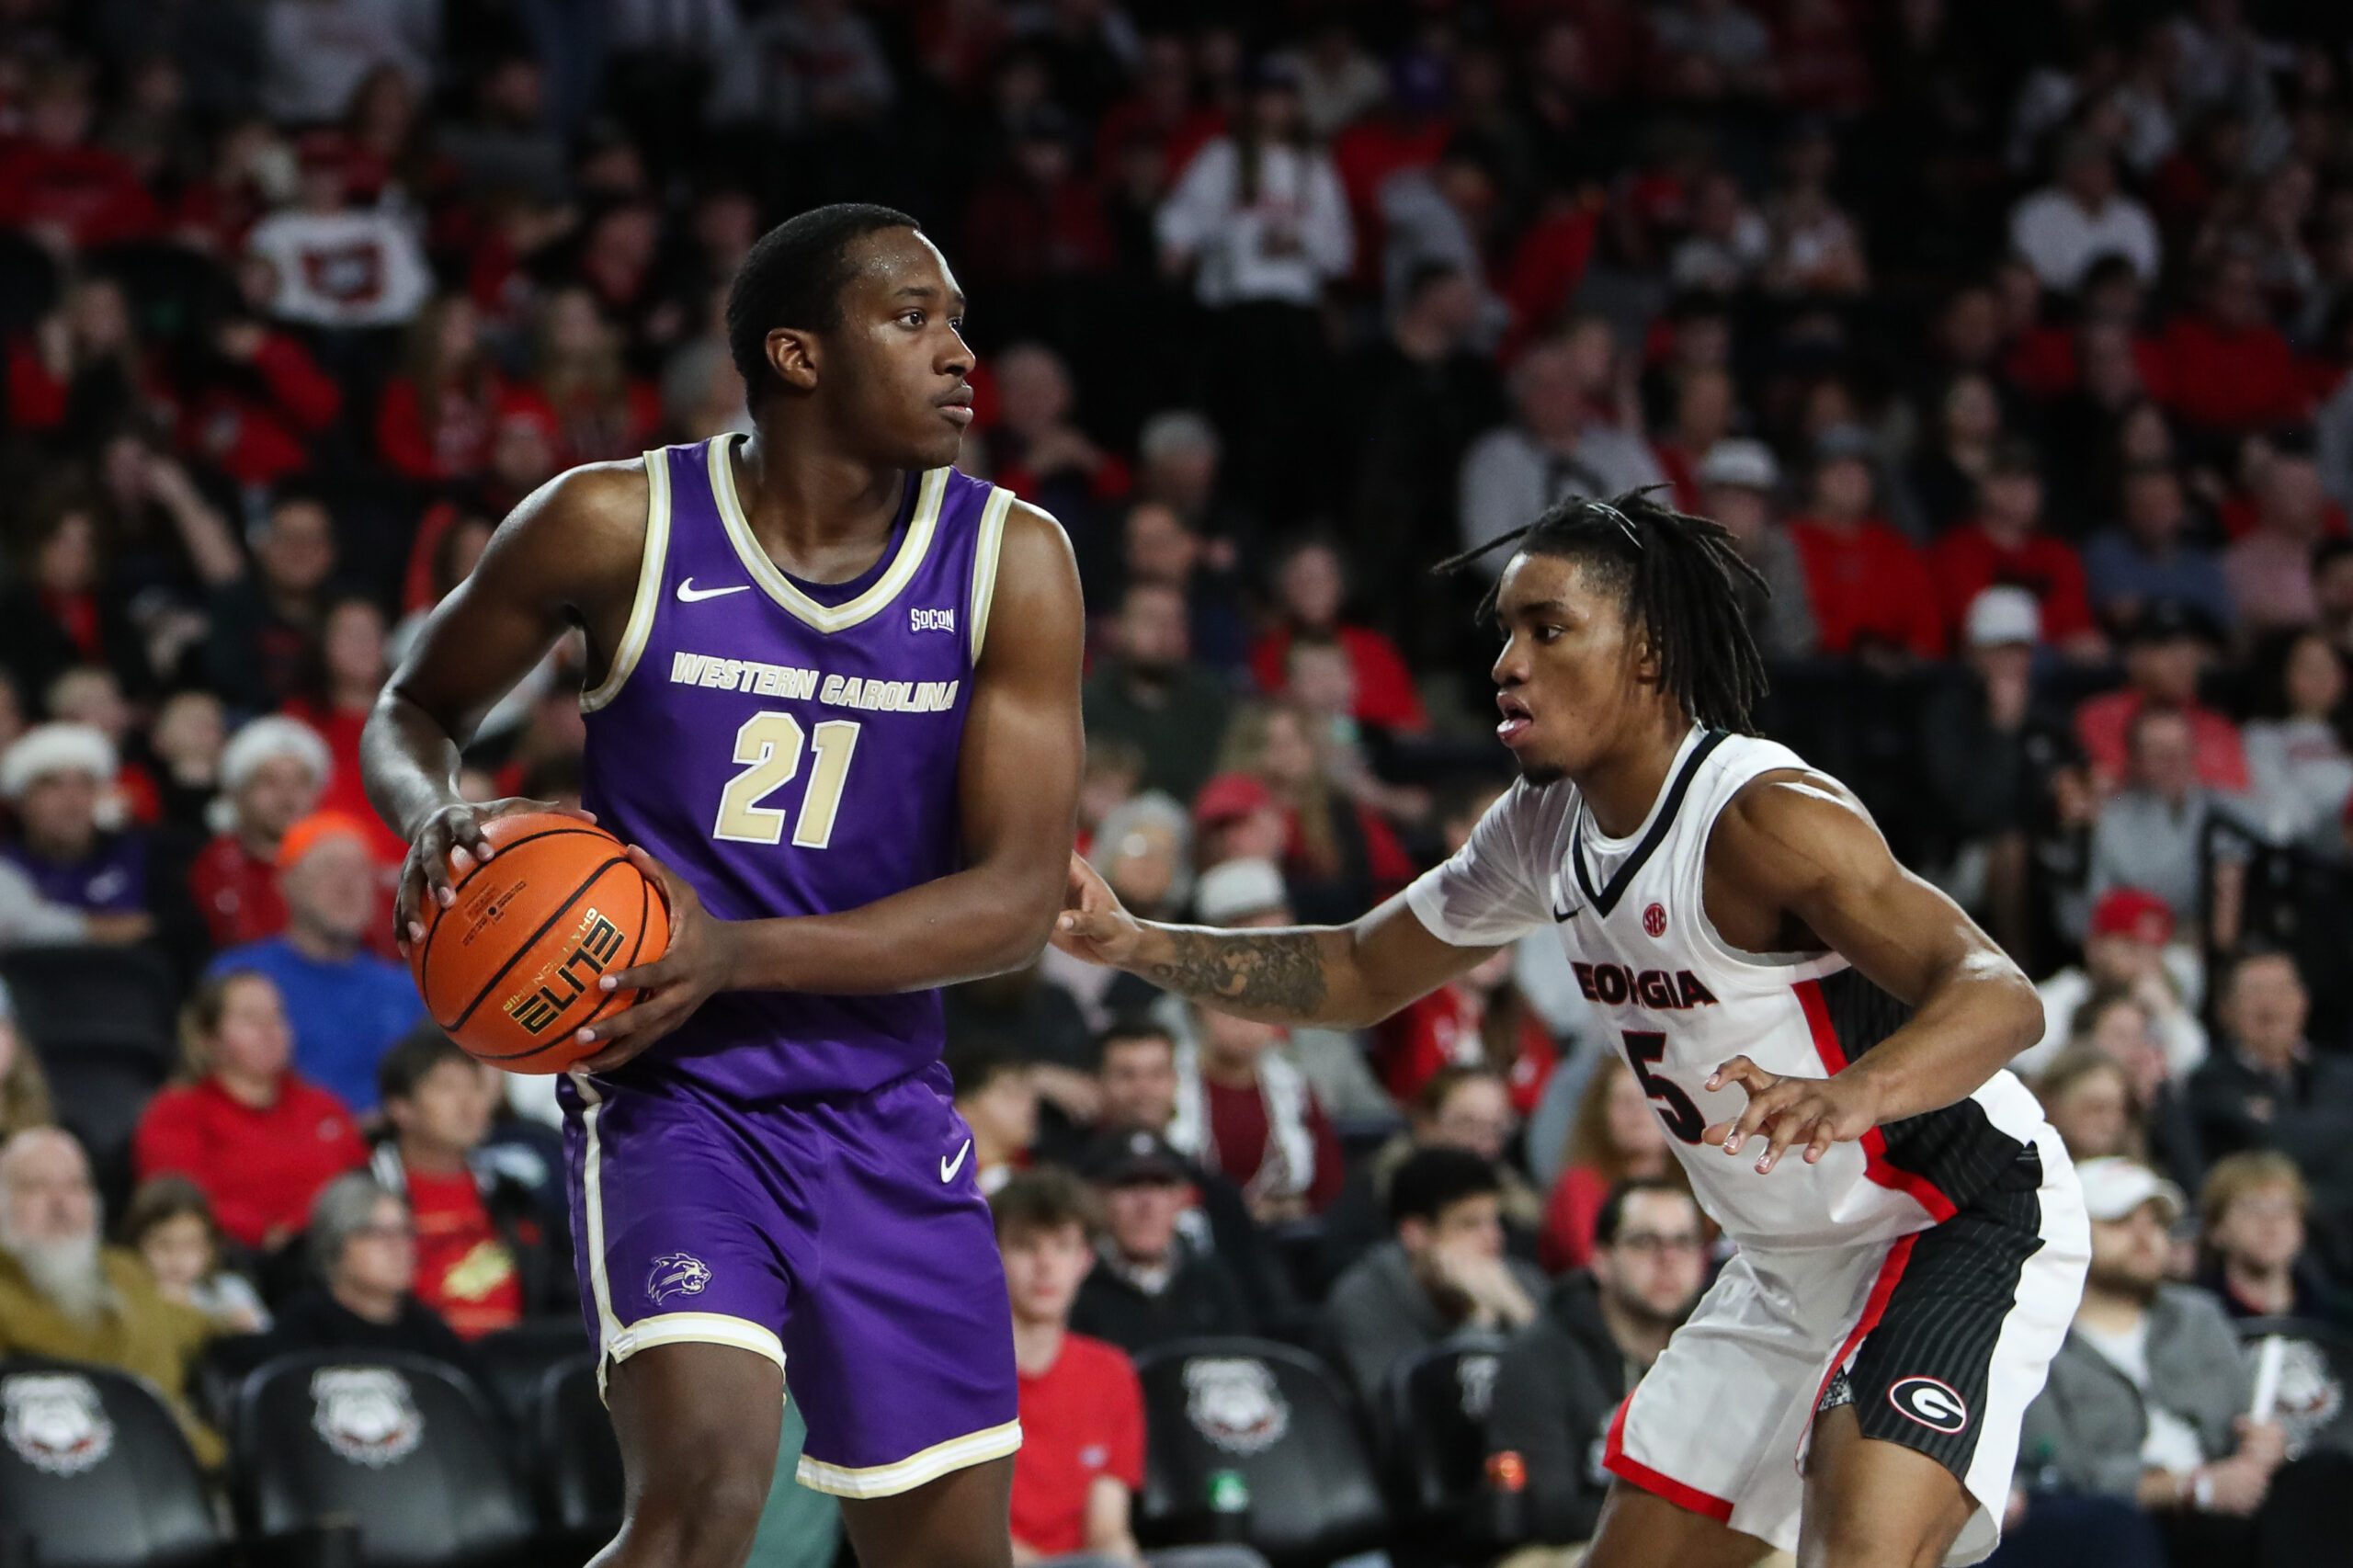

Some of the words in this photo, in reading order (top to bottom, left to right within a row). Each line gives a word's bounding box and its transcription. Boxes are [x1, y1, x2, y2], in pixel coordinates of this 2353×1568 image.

[670, 652, 819, 700] WESTERN
[820, 674, 959, 711] CAROLINA
[713, 710, 860, 849] 21
[1643, 904, 1665, 936] SEC
[509, 914, 625, 1036] ELITE
[1621, 1029, 1706, 1145] 5
[1889, 1377, 1966, 1432] G
